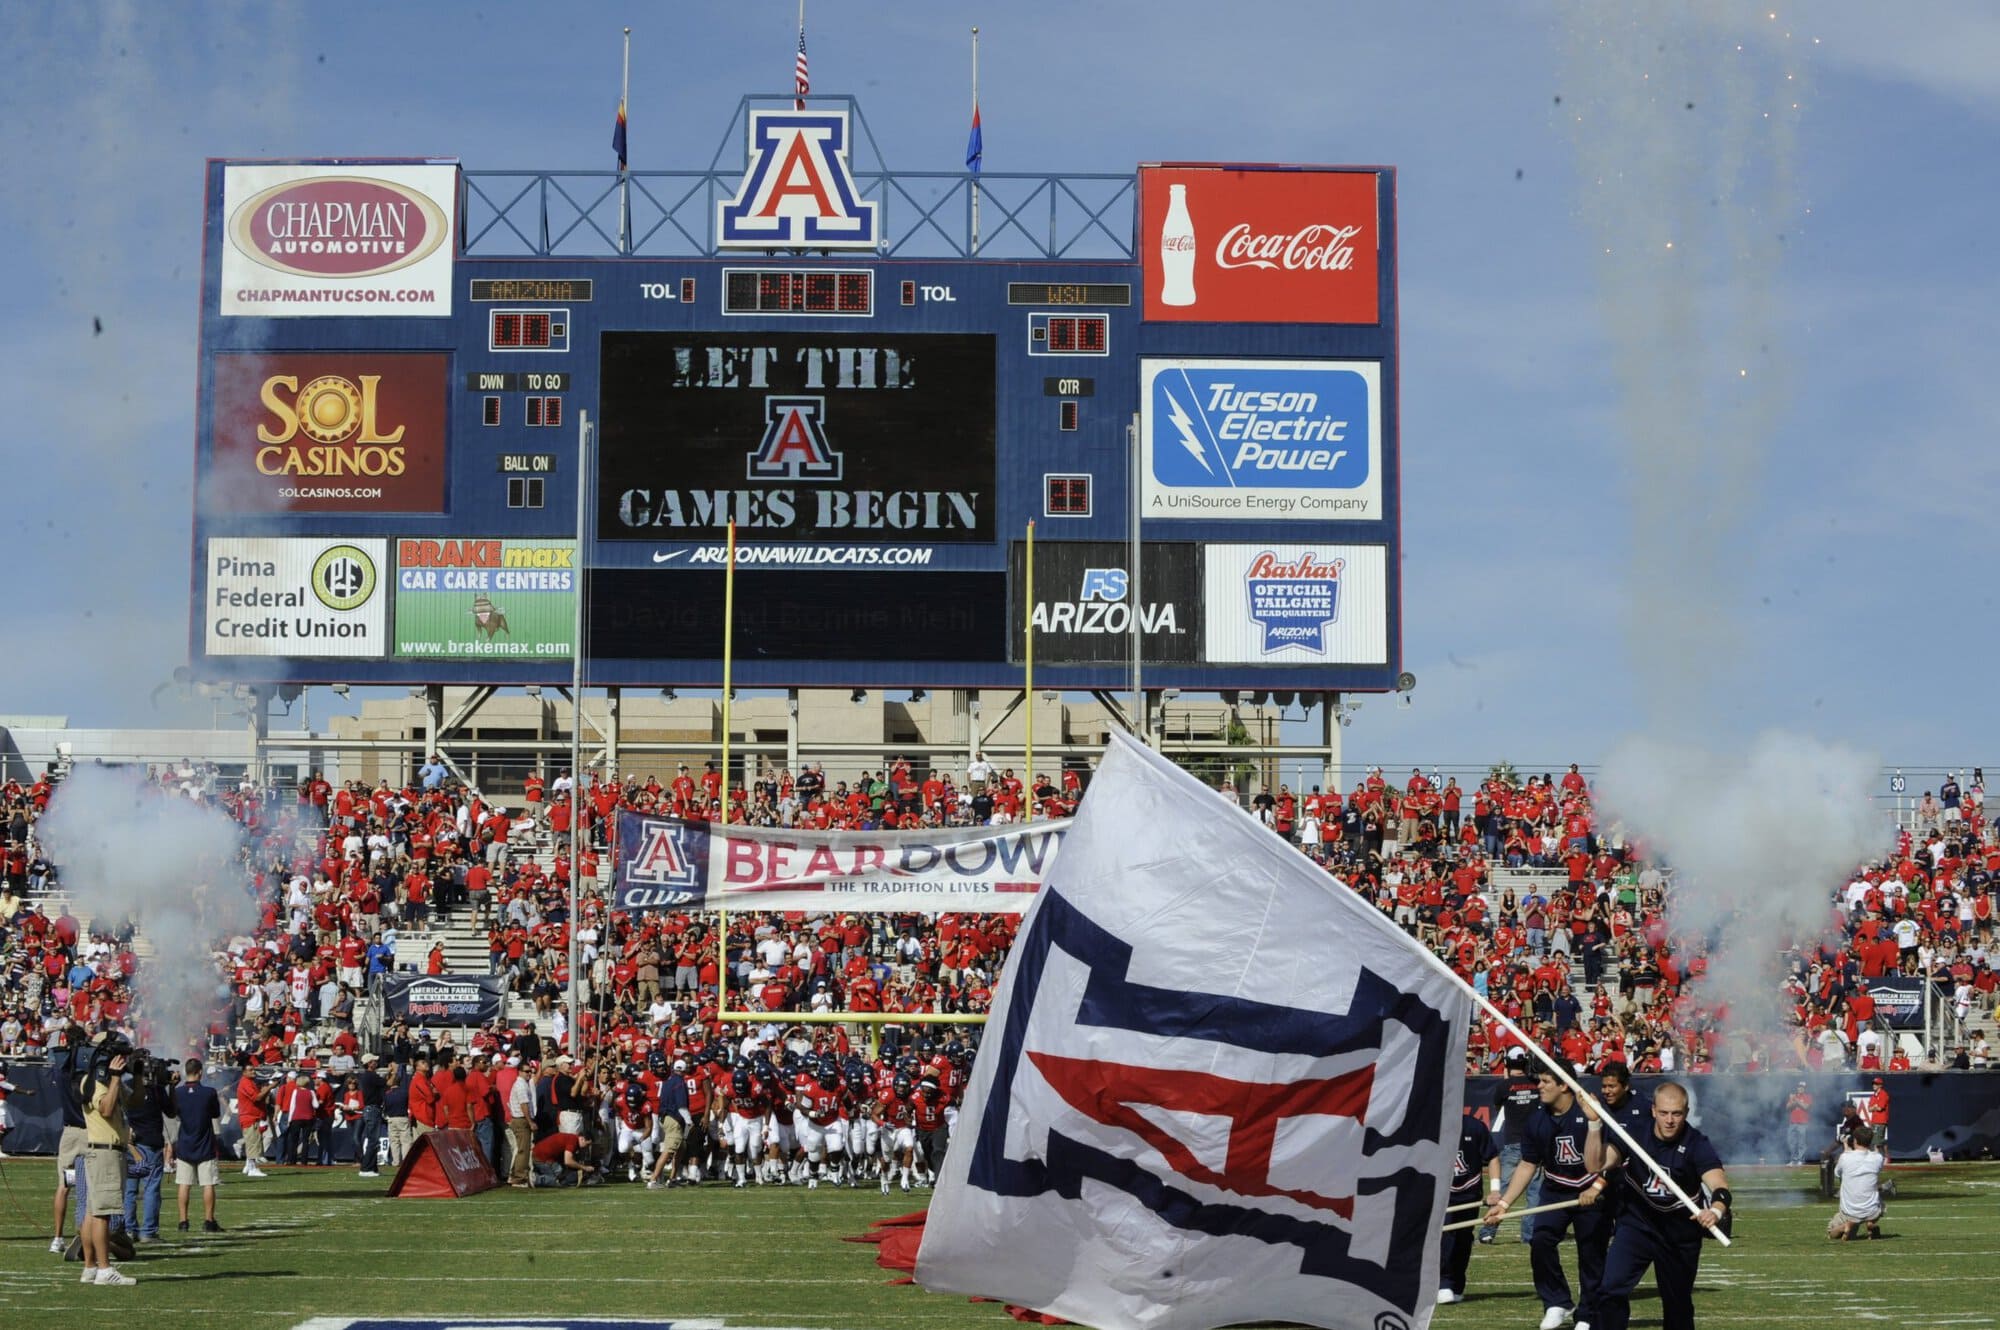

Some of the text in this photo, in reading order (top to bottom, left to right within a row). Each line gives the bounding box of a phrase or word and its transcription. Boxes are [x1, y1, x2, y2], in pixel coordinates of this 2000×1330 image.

[717, 110, 879, 247] A
[266, 202, 408, 239] CHAPMAN
[270, 240, 405, 255] AUTOMOTIVE
[1215, 223, 1363, 271] Coca-Cola
[236, 289, 436, 303] CHAPMANTUCSON.COM
[492, 281, 572, 300] ARIZONA
[640, 283, 676, 299] TOL
[920, 286, 957, 301] TOL
[1048, 286, 1087, 304] WSU
[672, 347, 916, 390] LET THE
[480, 374, 504, 390] DWN
[528, 374, 561, 390] TO GO
[1059, 379, 1079, 395] QTR
[1208, 383, 1318, 413] Tucson
[257, 375, 406, 444] SOL
[1219, 413, 1348, 442] Electric
[255, 447, 406, 476] CASINOS
[504, 456, 548, 471] BALL ON
[1232, 443, 1348, 471] Power
[278, 488, 381, 498] SOLCASINOS.COM
[619, 489, 980, 530] GAMES BEGIN
[1152, 495, 1369, 512] A UniSource Energy Company
[216, 557, 276, 577] Pima
[1248, 554, 1341, 578] Bashas'
[402, 572, 571, 590] CAR CARE CENTERS
[1080, 568, 1129, 600] FS
[216, 587, 305, 608] Federal
[1255, 585, 1331, 596] OFFICIAL
[1255, 598, 1331, 609] TAILGATE
[1024, 602, 1176, 634] ARIZONA
[1255, 610, 1331, 618] HEADQUARTERS
[215, 618, 367, 638] Credit Union
[1268, 627, 1318, 637] ARIZONA
[401, 640, 570, 655] www.brakemax.com
[1891, 778, 1905, 791] 30
[626, 819, 699, 887] A
[724, 831, 1067, 883] BEAR DOW
[830, 882, 990, 893] THE TRADITION LIVES
[818, 1097, 838, 1113] 54
[1554, 1135, 1585, 1166] A
